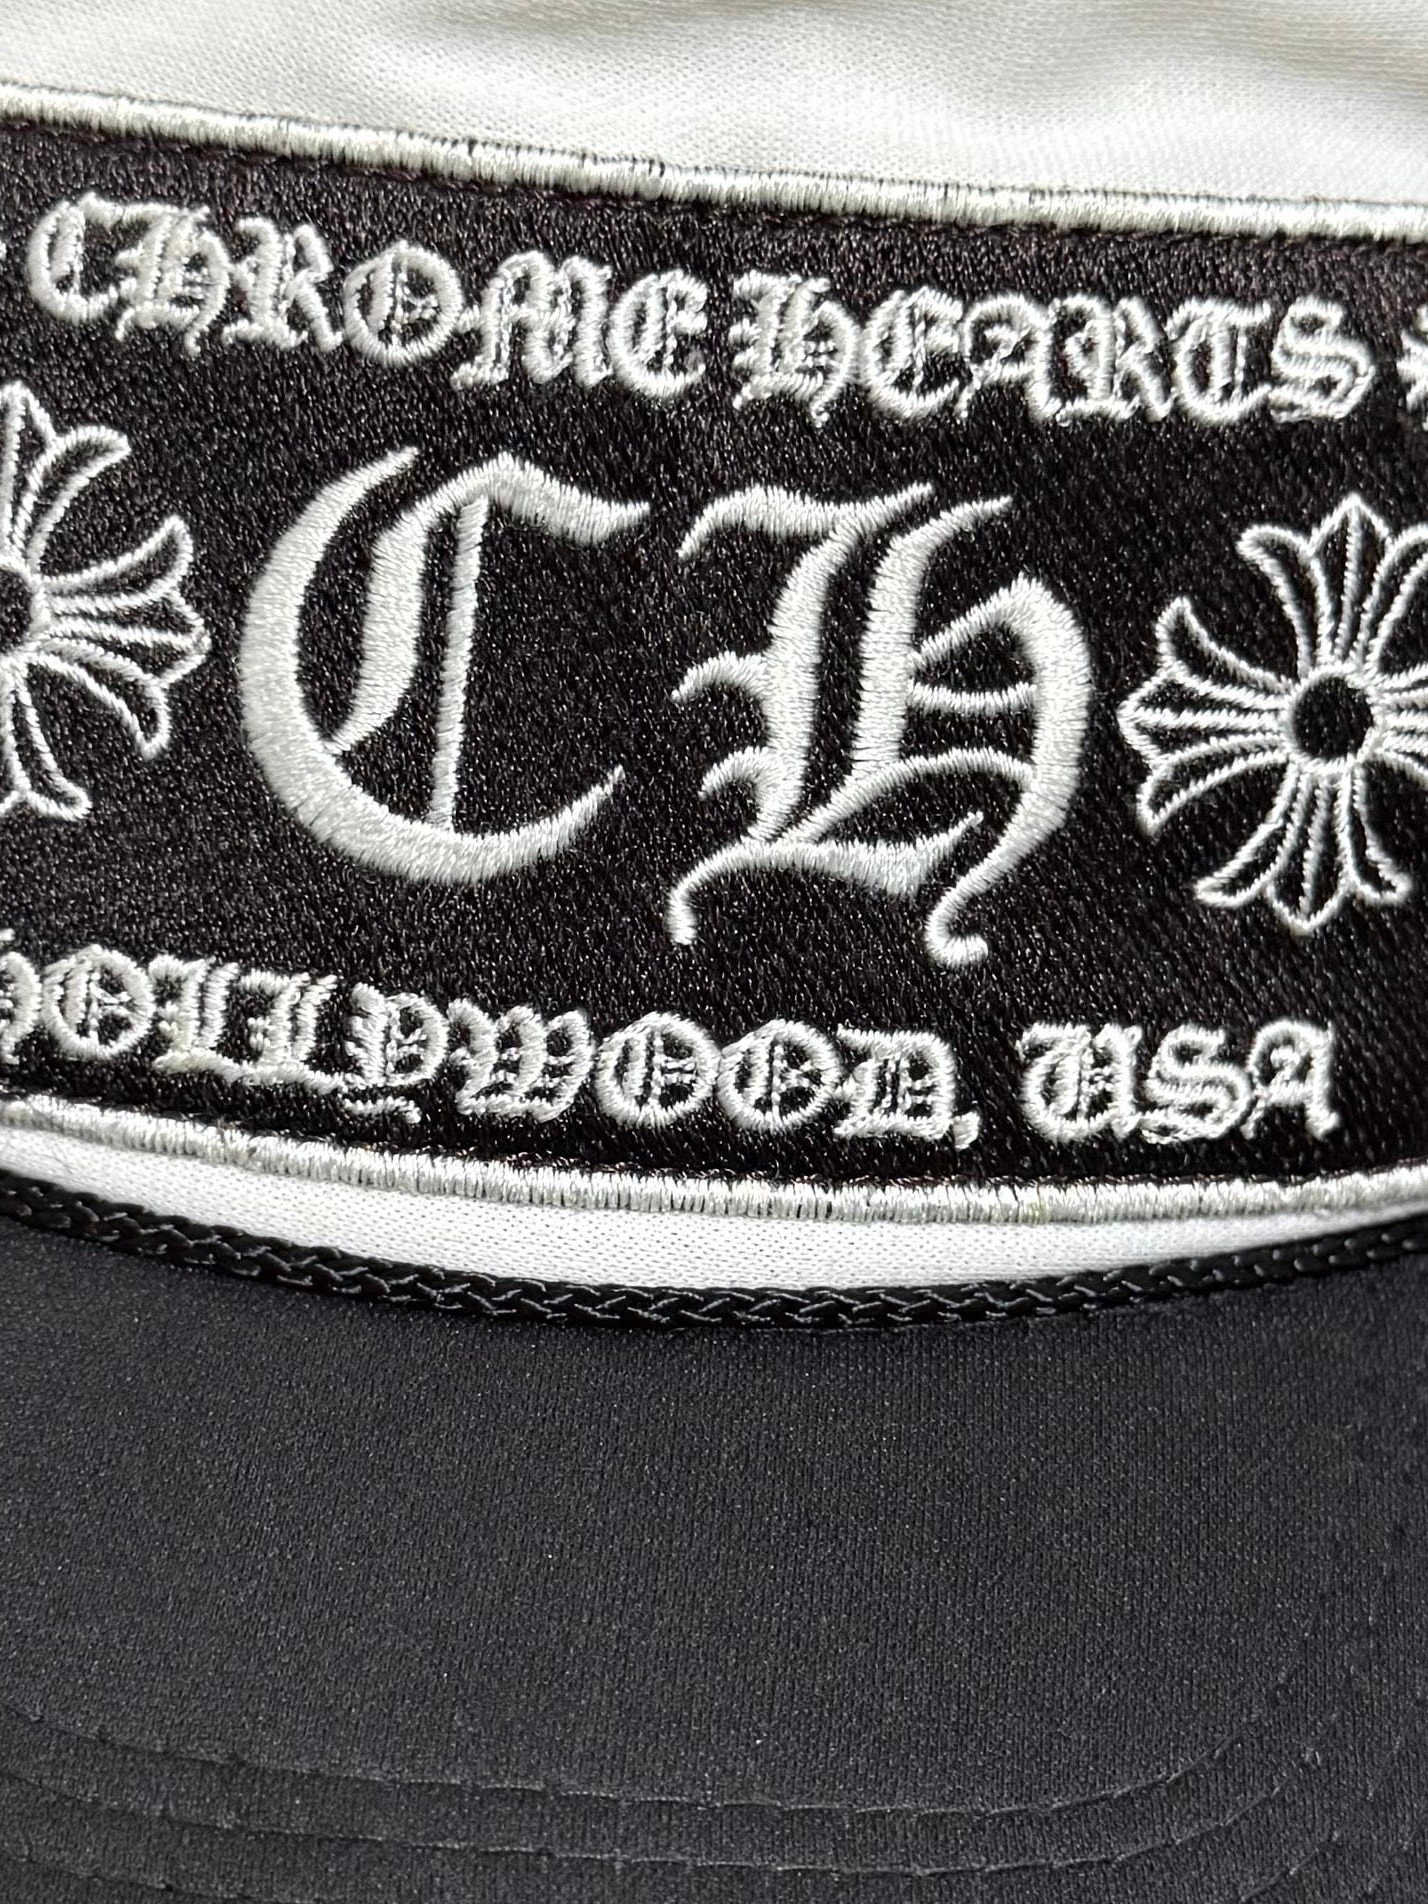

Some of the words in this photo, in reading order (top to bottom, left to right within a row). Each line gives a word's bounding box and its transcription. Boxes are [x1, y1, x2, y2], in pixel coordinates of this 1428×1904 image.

[24, 190, 710, 398] CHROME
[729, 266, 1379, 430] HEARTS
[239, 442, 1093, 969] CH
[1019, 1016, 1338, 1142] USA
